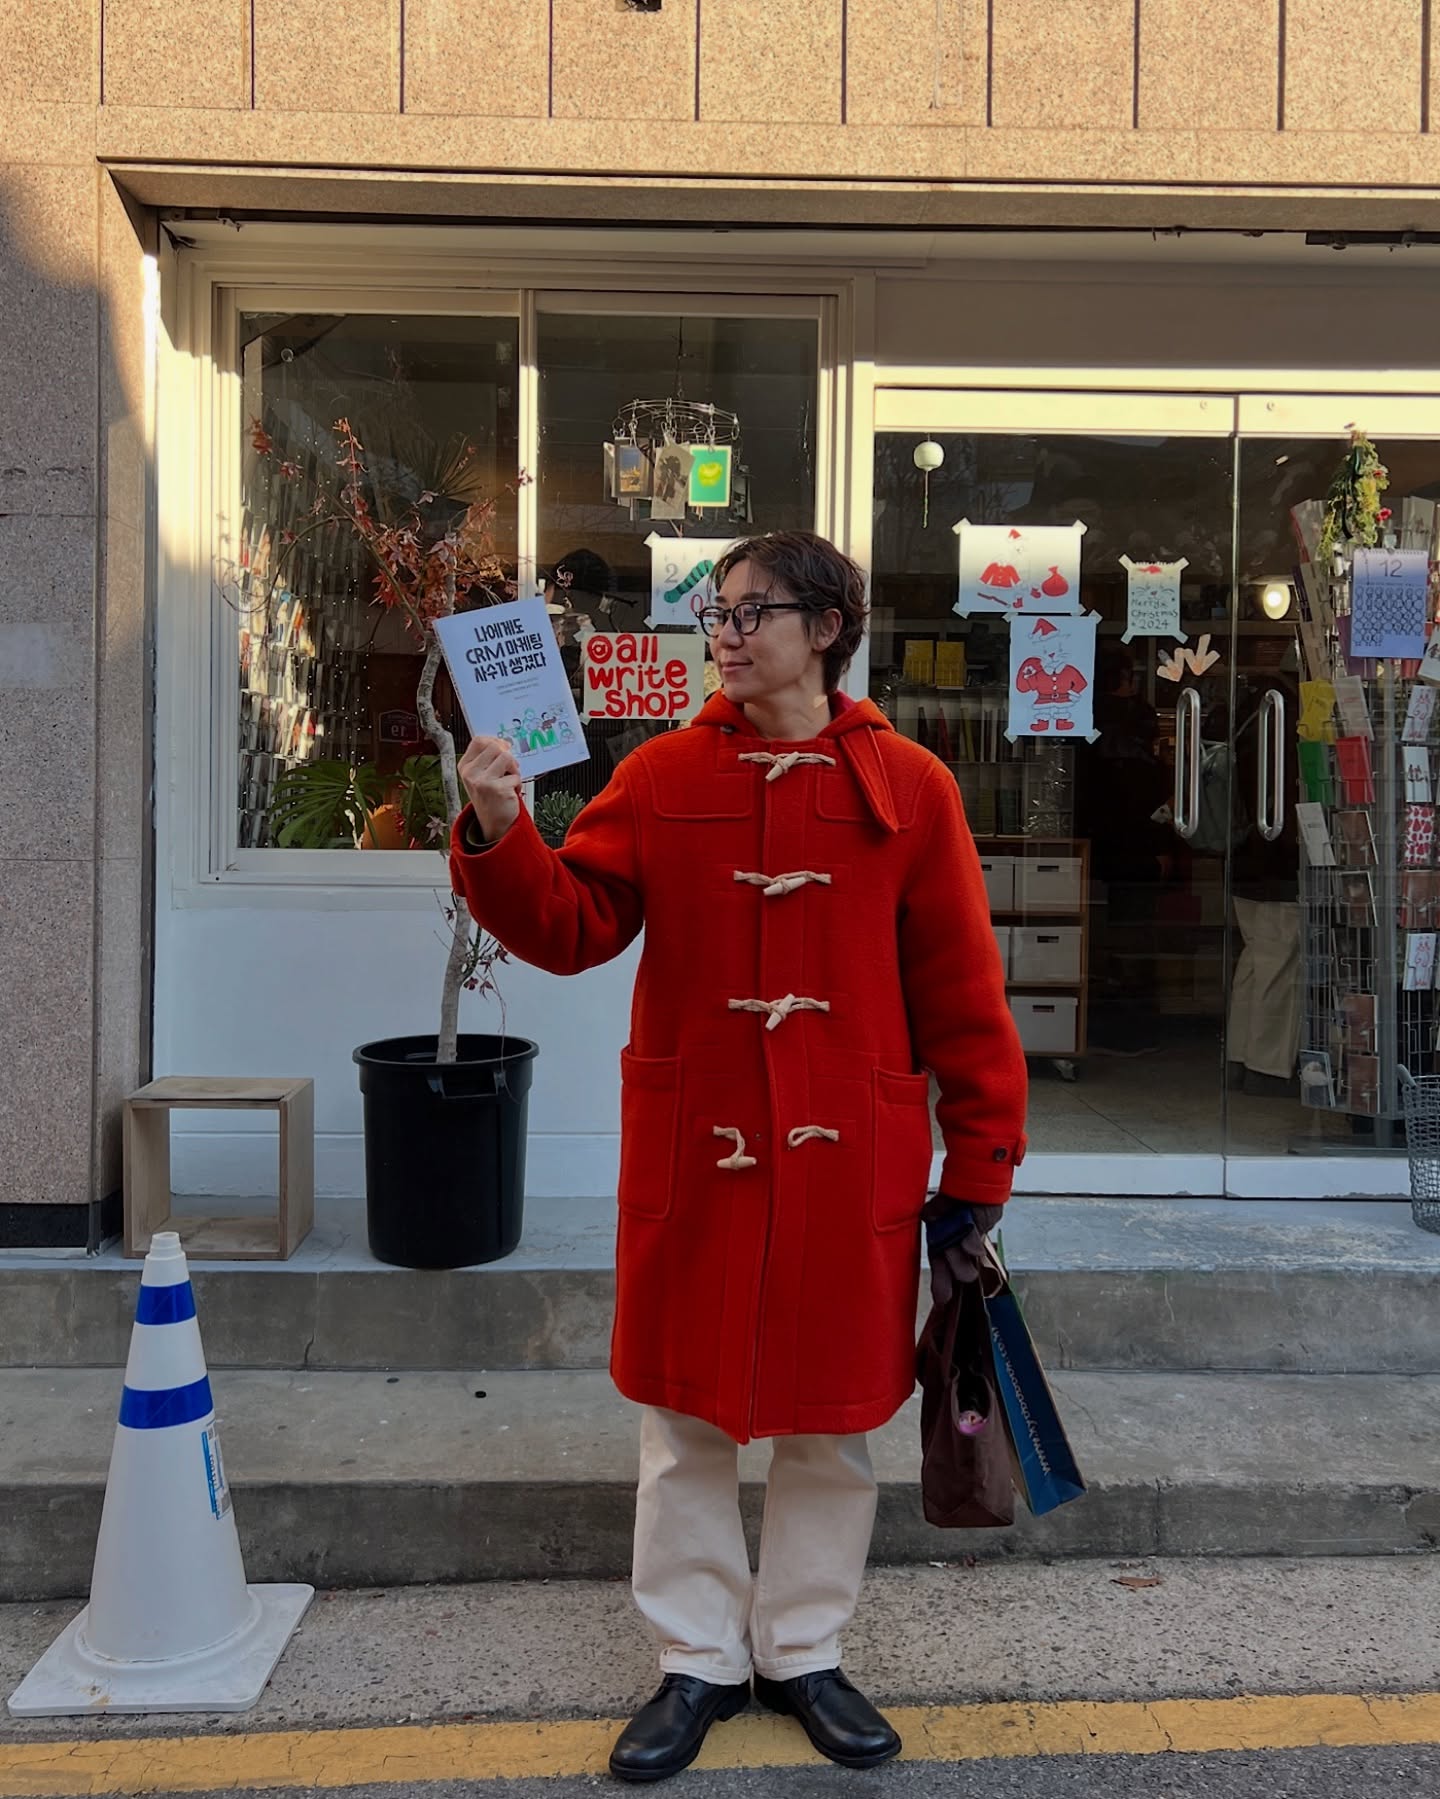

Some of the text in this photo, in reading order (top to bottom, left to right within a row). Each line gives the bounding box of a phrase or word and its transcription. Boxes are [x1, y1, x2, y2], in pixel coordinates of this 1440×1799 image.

[664, 564, 679, 584] 2
[1379, 560, 1403, 578] 12
[474, 618, 525, 643] 나에게도
[1139, 619, 1169, 629] 2024
[466, 633, 544, 665] CRM 마케팅
[474, 652, 547, 683] 사수가 생겼다
[588, 659, 688, 692] write
